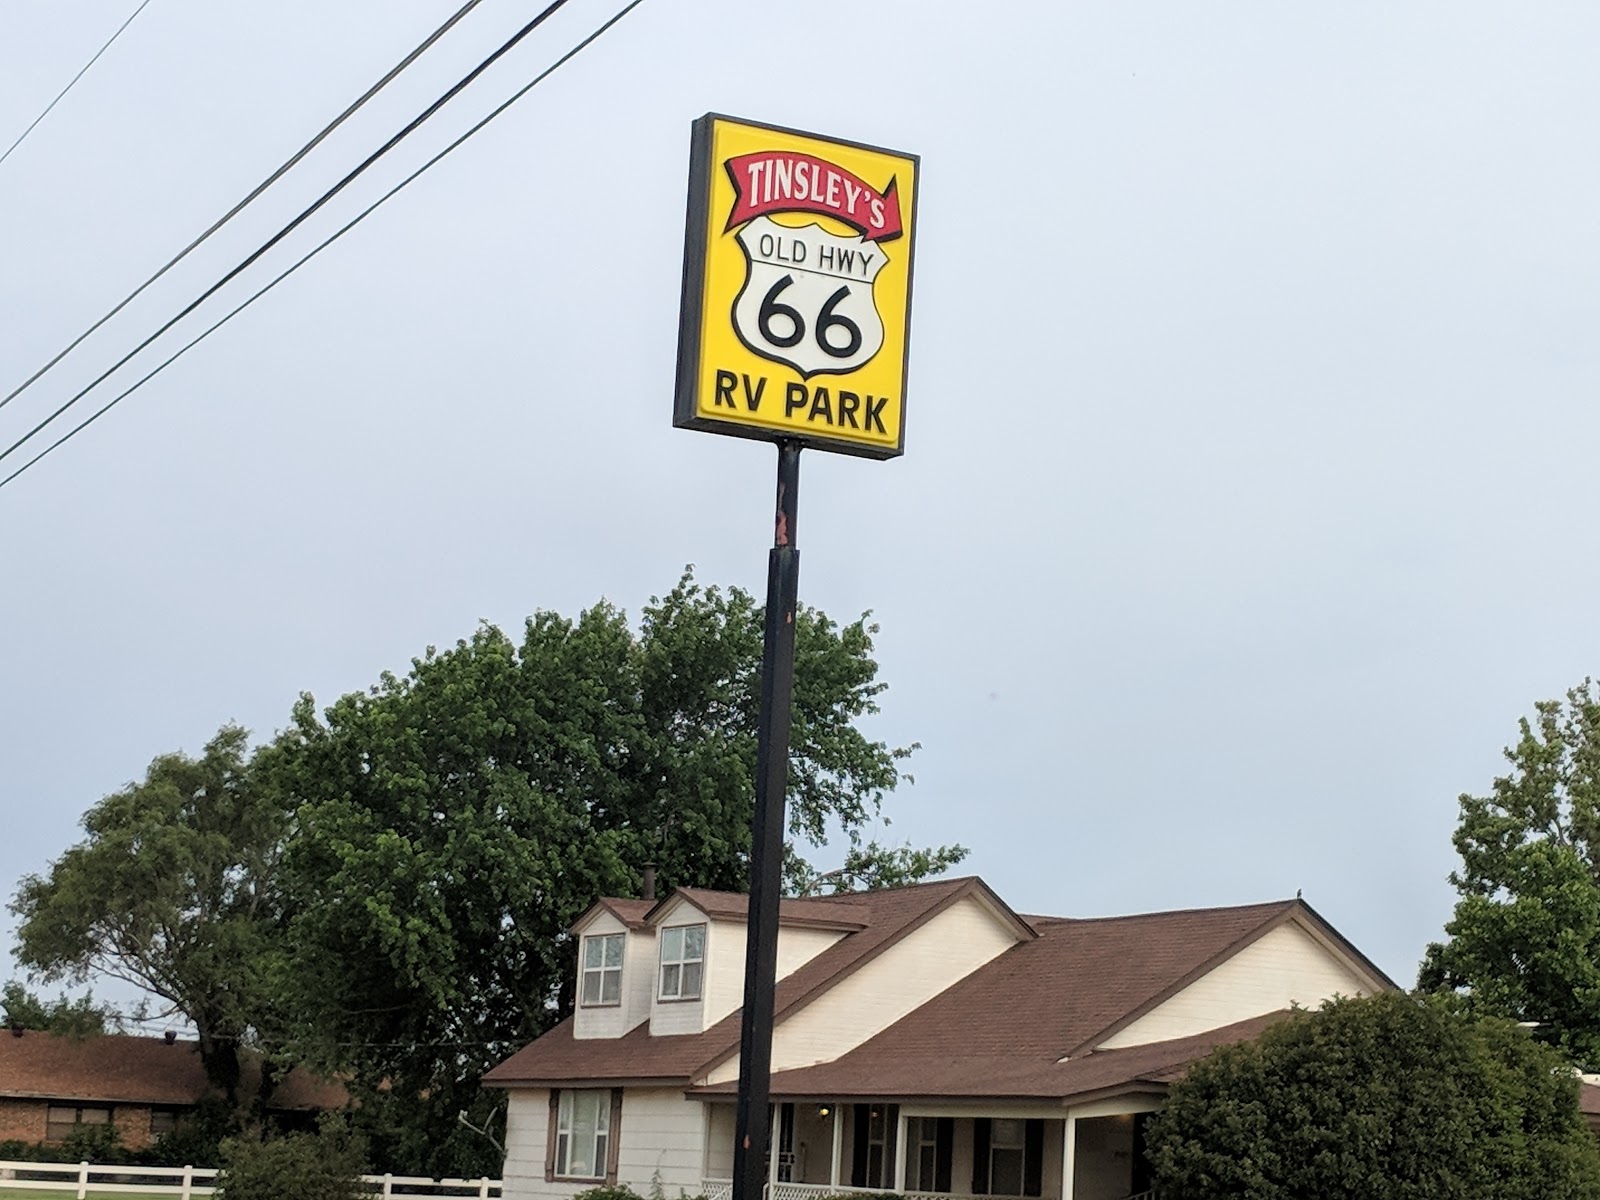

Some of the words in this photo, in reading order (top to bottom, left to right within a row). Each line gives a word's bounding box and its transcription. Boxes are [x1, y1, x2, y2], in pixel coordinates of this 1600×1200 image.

[748, 159, 885, 229] TINSLEY'S
[759, 233, 807, 263] OLD
[820, 245, 875, 276] HWY
[758, 274, 862, 358] 66
[715, 370, 768, 411] RV
[785, 382, 889, 435] PARK
